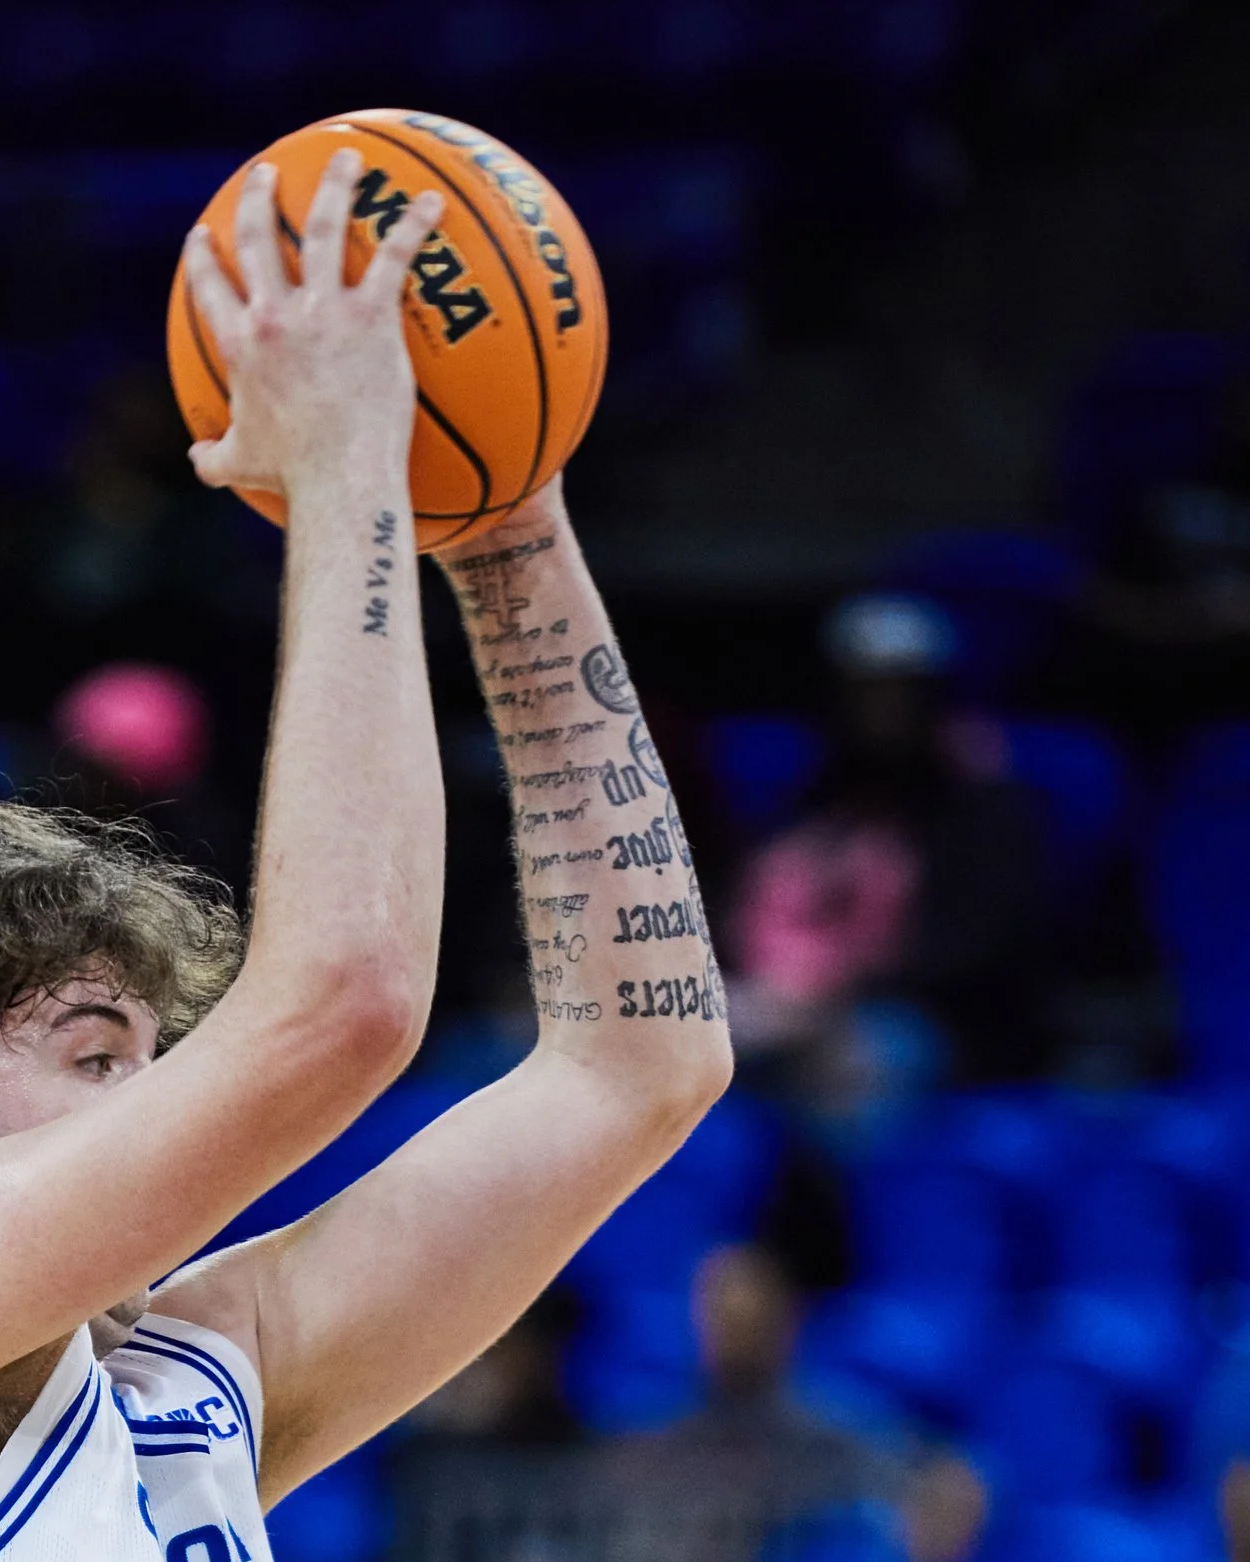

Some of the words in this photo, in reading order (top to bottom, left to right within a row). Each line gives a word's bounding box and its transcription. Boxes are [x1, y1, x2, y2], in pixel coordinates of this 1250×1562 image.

[401, 112, 582, 335] Wilson
[371, 510, 397, 551] Me
[362, 597, 390, 637] Me
[601, 758, 647, 808] up
[553, 798, 592, 826] you
[604, 815, 675, 877] give
